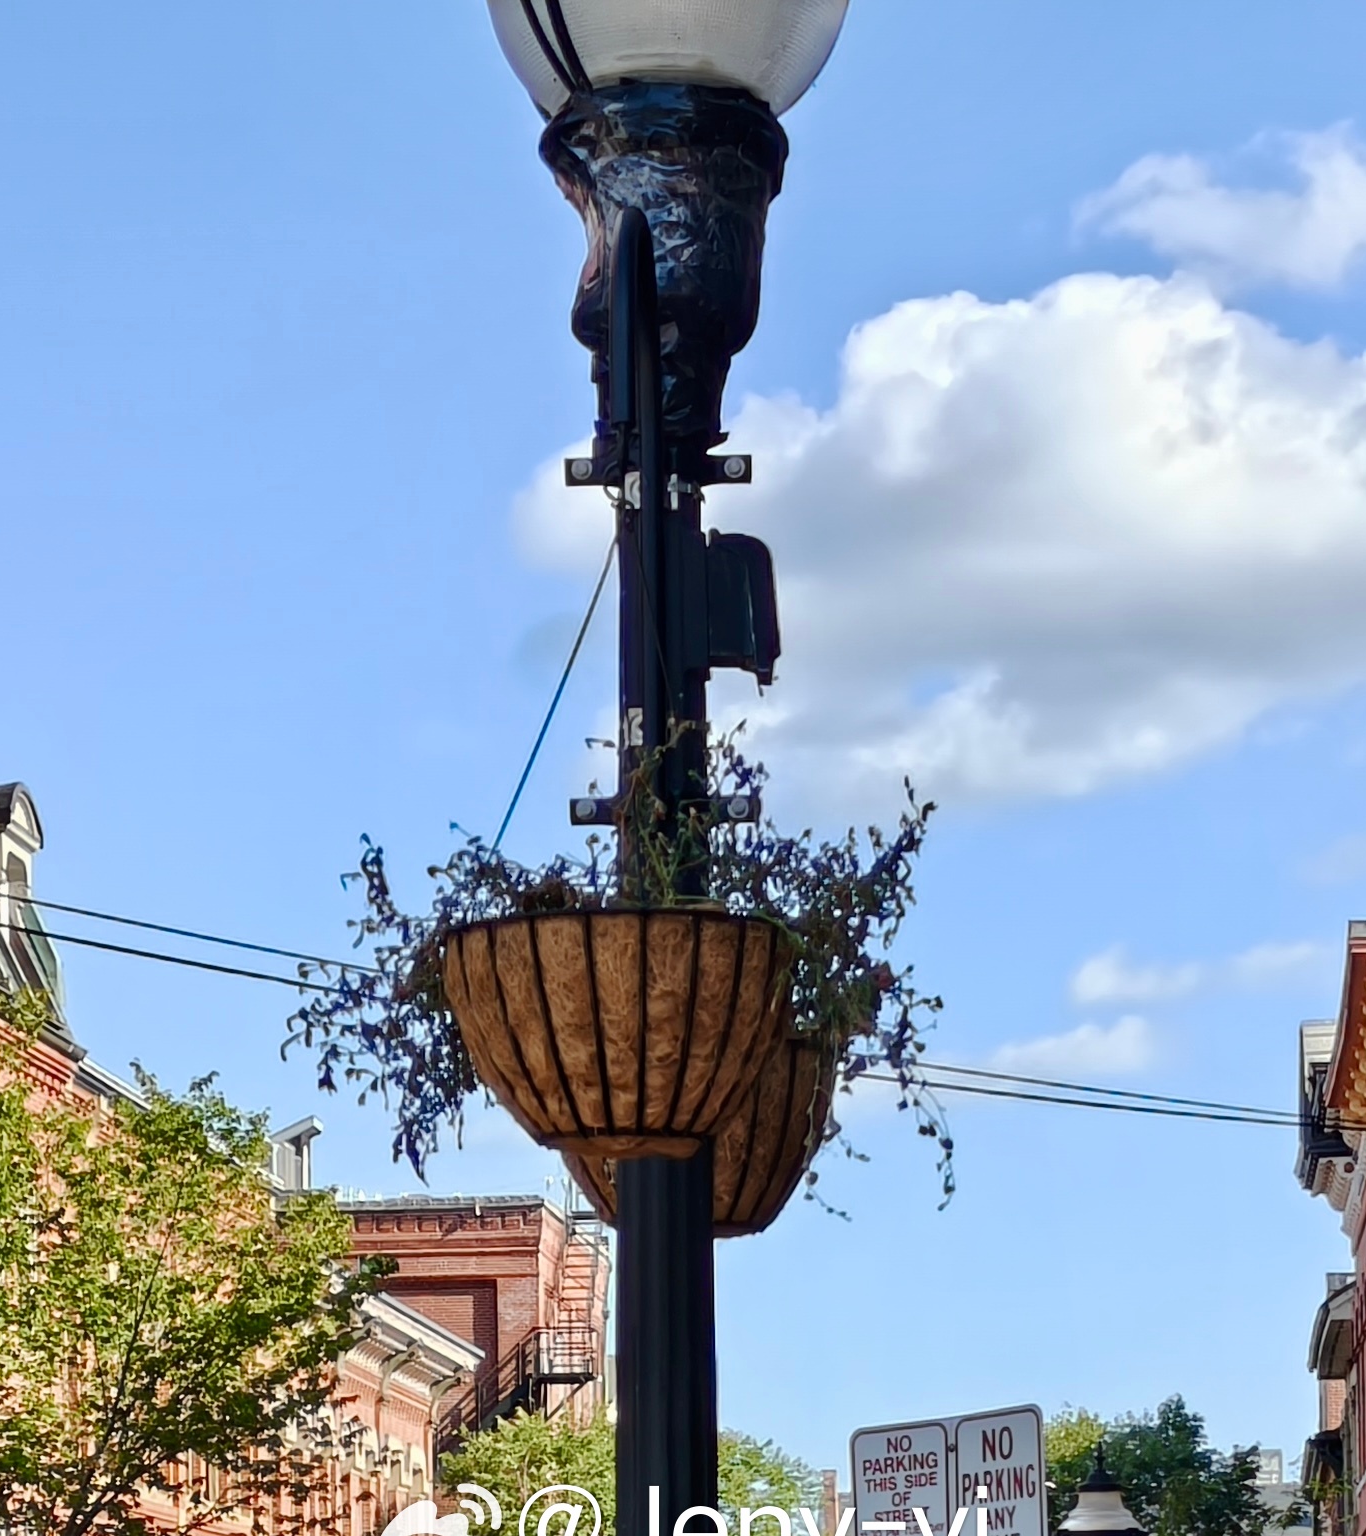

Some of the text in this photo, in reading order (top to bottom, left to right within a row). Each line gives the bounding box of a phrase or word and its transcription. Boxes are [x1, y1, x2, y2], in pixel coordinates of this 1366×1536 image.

[887, 1434, 912, 1454] NO
[981, 1426, 1013, 1463] NO
[862, 1451, 938, 1477] PARKING
[865, 1472, 938, 1493] THIS SIDE
[962, 1464, 1036, 1506] PARKING
[891, 1491, 912, 1507] OF
